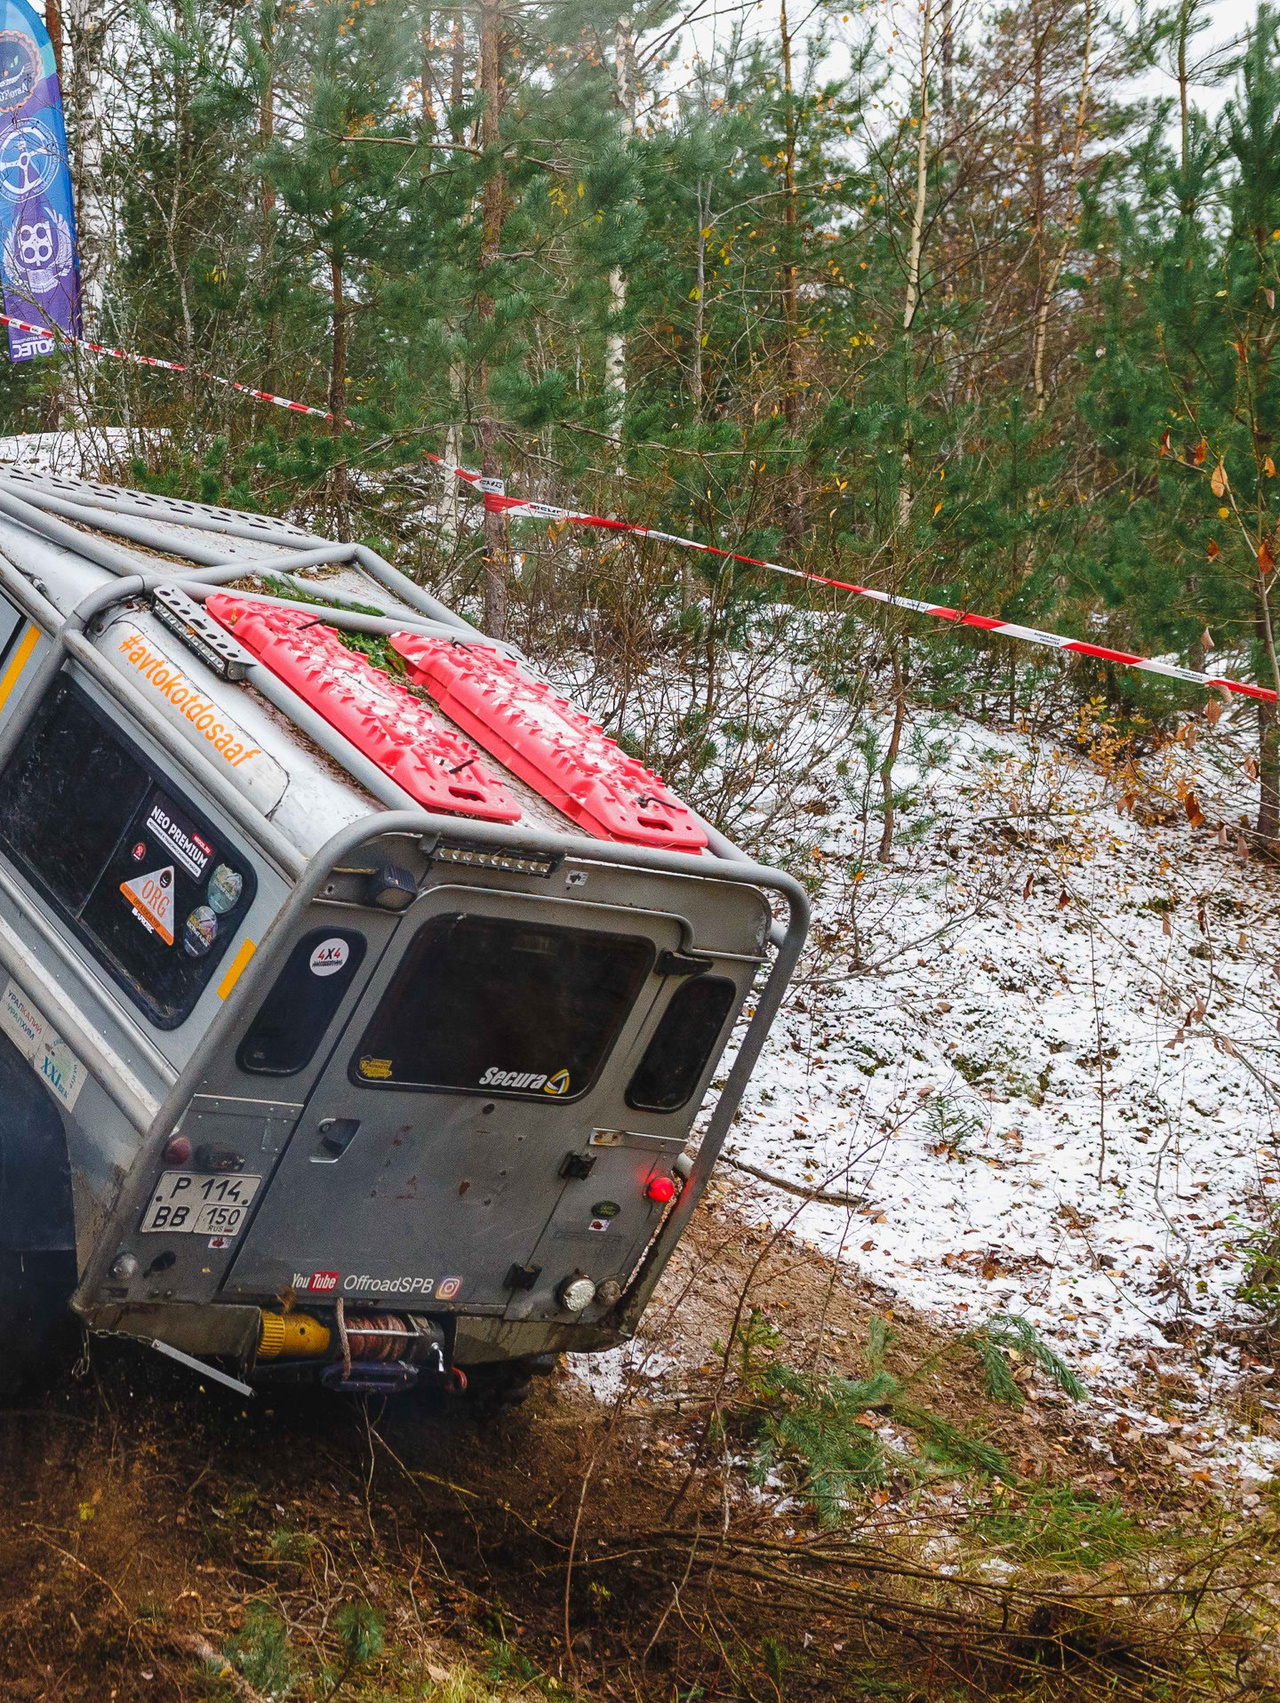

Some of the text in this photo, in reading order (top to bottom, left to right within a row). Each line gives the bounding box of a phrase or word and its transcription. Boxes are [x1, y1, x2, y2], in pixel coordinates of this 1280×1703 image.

[118, 634, 262, 768] #avtokotdosaaf
[151, 805, 209, 868] NEO PREMIUM
[141, 879, 170, 918] ORG
[7, 1004, 35, 1041] УРАЛХИМ
[41, 1055, 63, 1087] XXI
[478, 1066, 547, 1090] Secura
[200, 1178, 243, 1202] 114
[206, 1207, 241, 1226] 150
[343, 1274, 434, 1294] OffroadSPB
